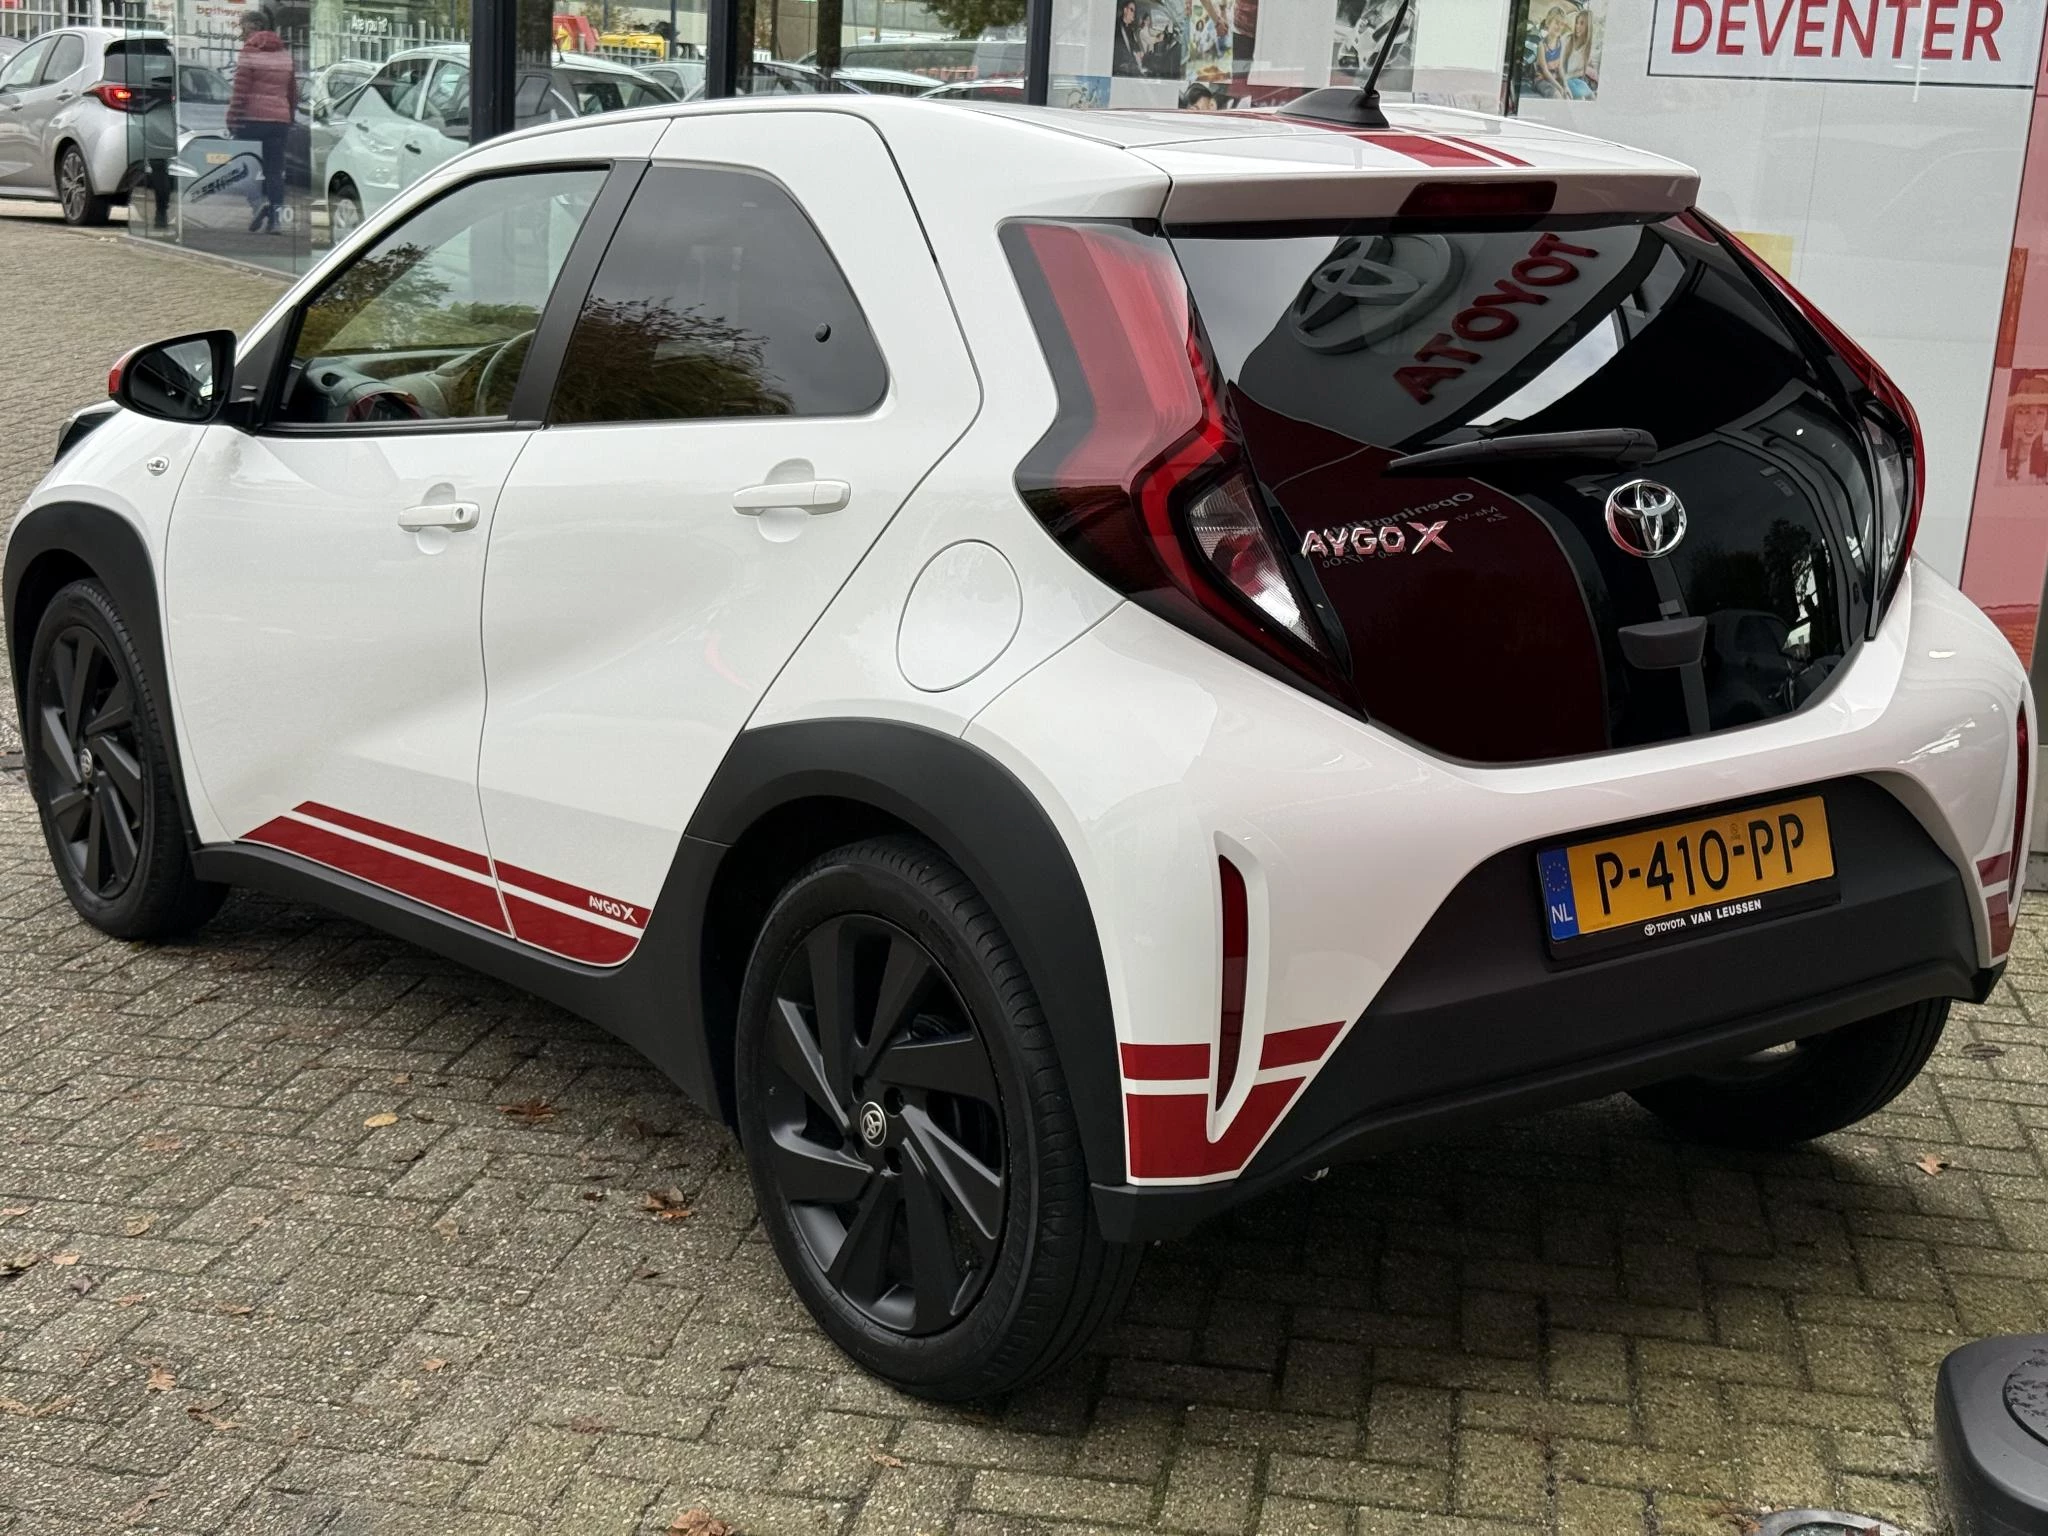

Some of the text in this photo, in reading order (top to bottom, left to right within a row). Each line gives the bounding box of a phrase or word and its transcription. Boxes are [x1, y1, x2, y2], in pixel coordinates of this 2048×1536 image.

[1671, 0, 2004, 62] DEVENTER
[275, 206, 294, 223] 10
[1301, 525, 1406, 558] AYGO
[1407, 520, 1454, 555] X
[1595, 812, 1805, 916] P-410-PP
[588, 894, 638, 925] AYGO X
[1551, 903, 1574, 925] NL
[1656, 899, 1762, 933] TOYOTA VAN LEUSSEN
